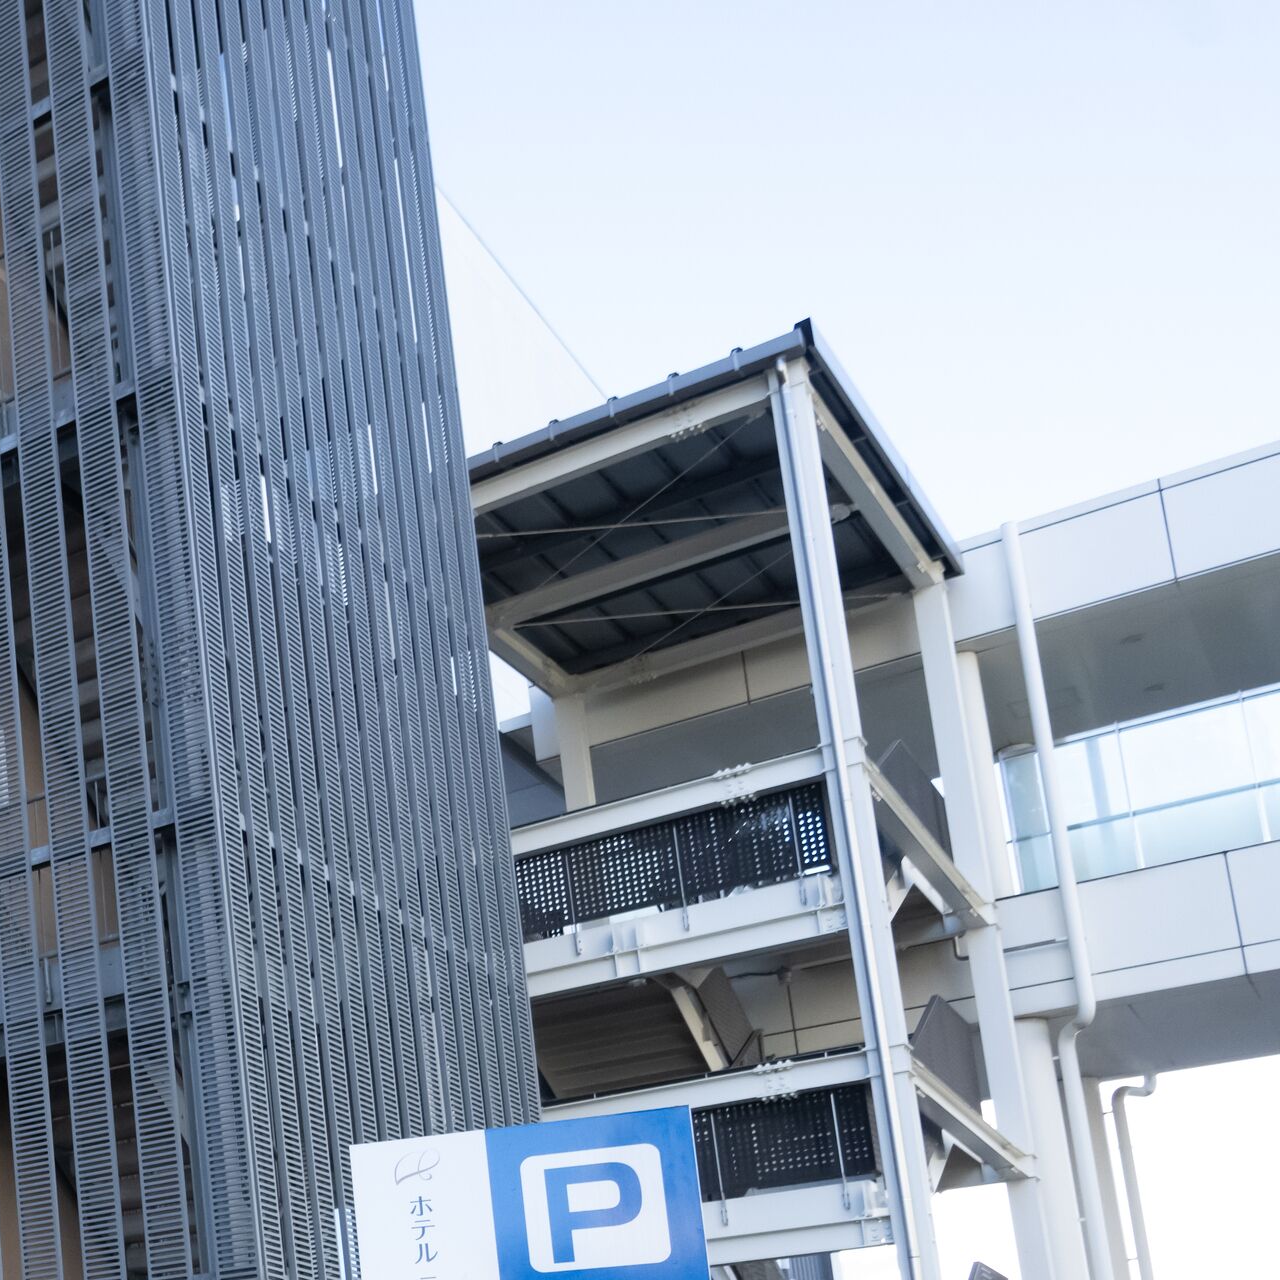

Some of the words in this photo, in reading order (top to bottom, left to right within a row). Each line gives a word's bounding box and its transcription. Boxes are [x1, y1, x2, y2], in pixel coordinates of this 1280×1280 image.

[409, 1196, 439, 1265] ホテル
[543, 1161, 643, 1265] P
